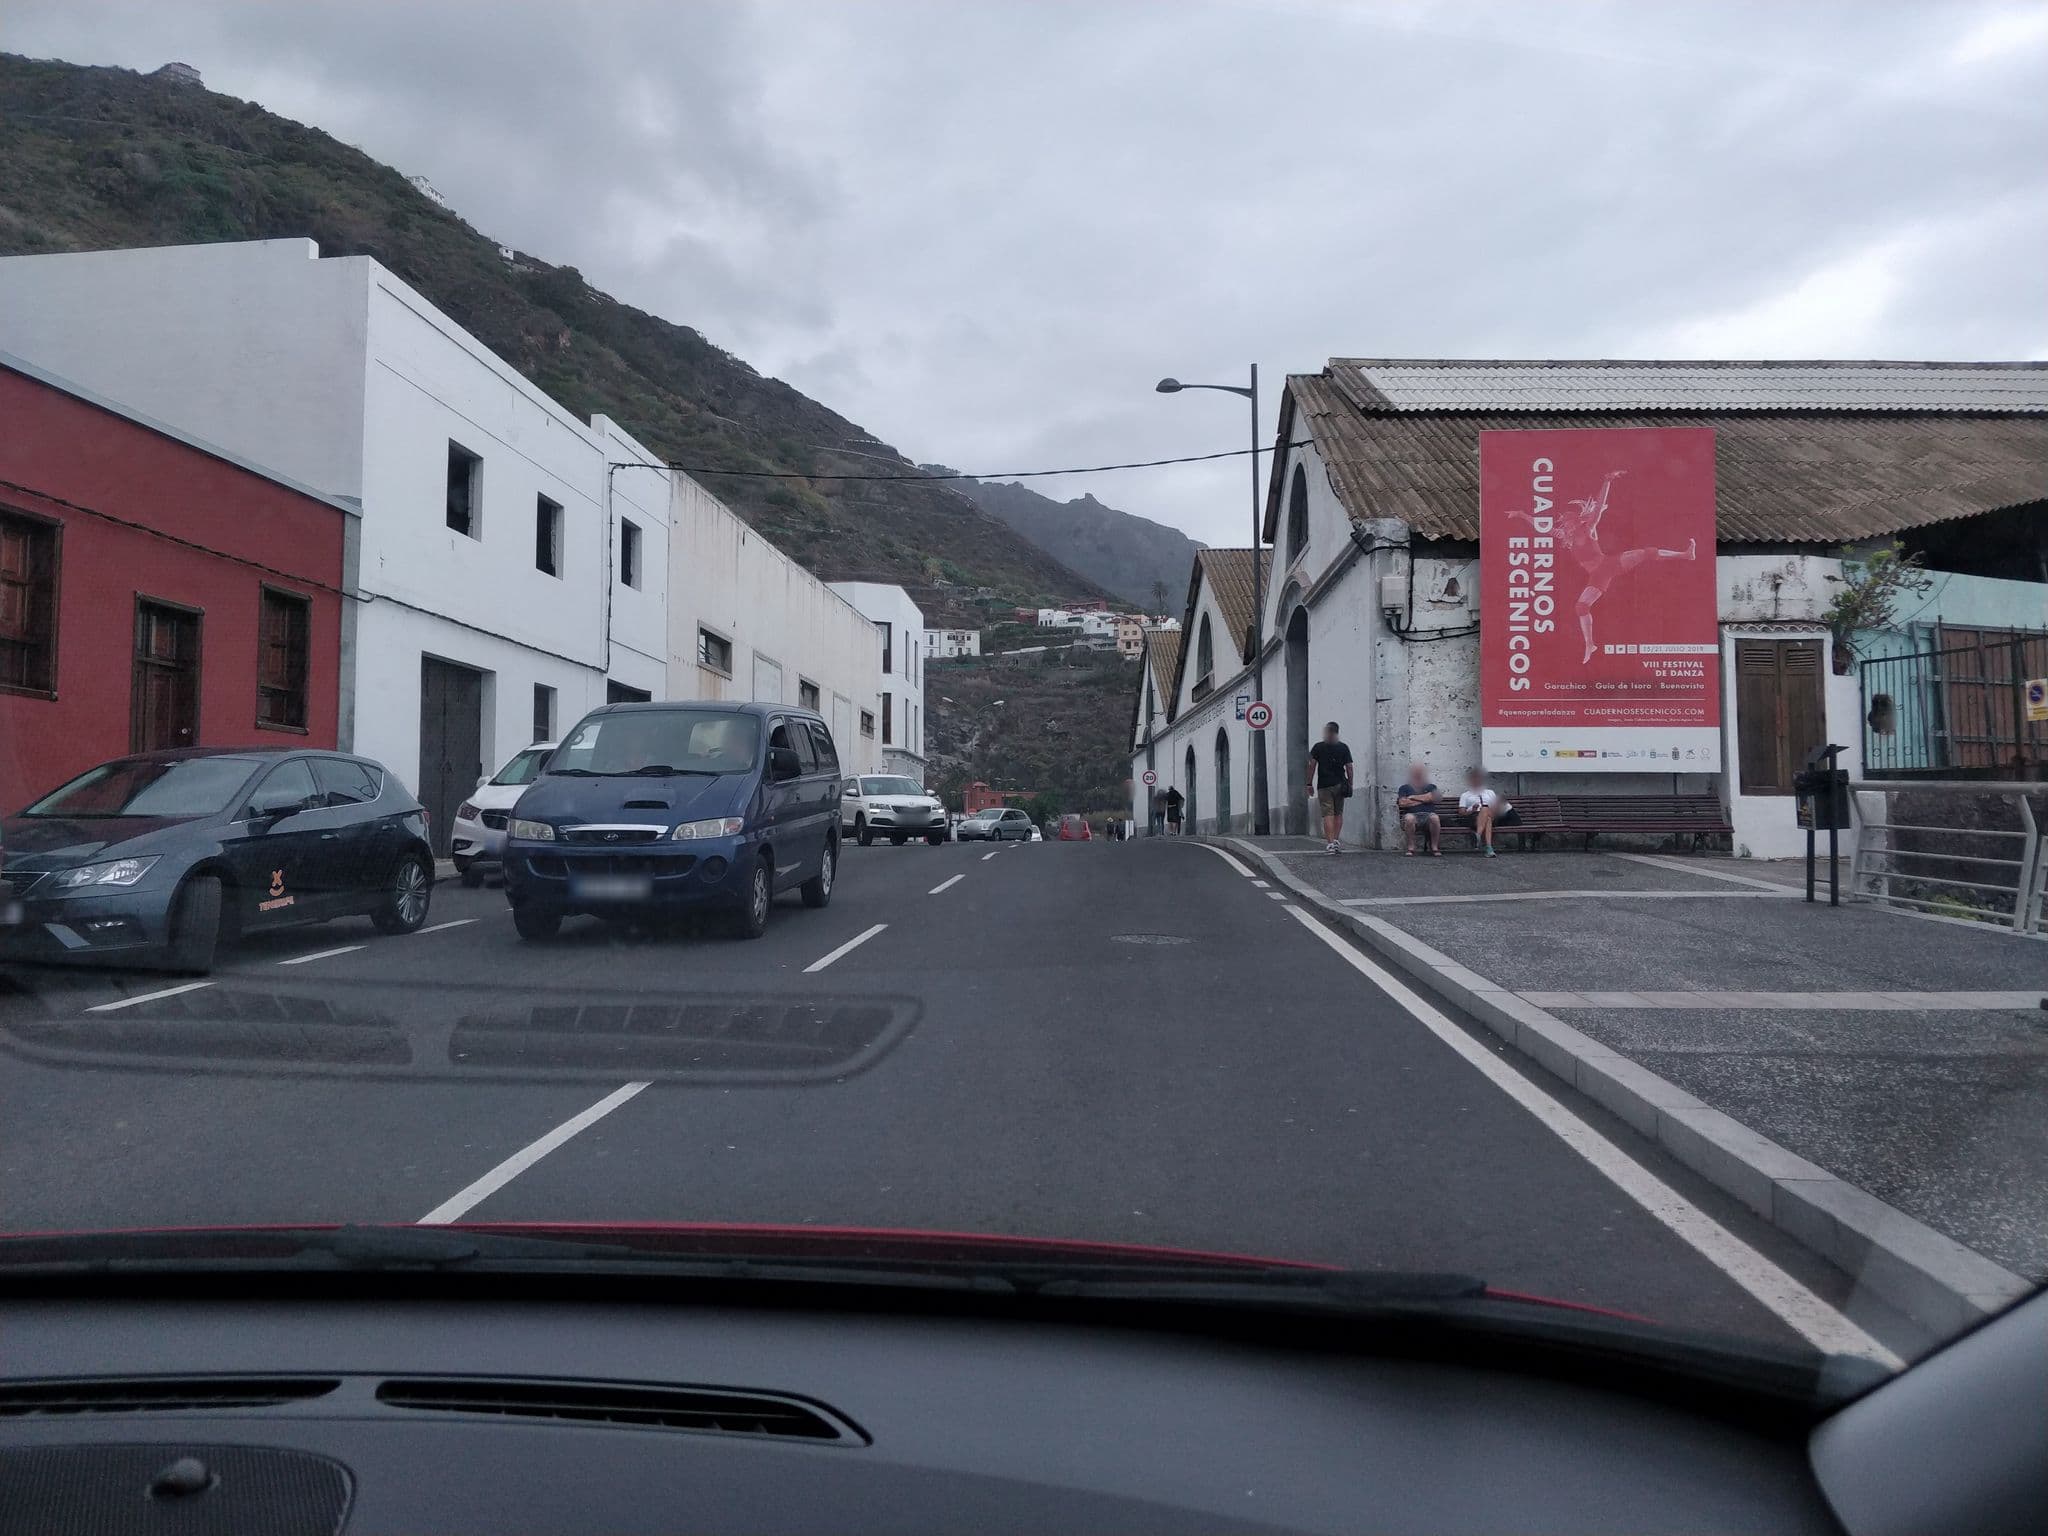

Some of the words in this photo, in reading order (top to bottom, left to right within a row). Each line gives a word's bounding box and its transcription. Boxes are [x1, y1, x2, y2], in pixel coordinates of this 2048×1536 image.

[1532, 457, 1554, 633] CUADERNOS
[1655, 669, 1668, 677] DE
[1670, 669, 1704, 677] DANZA
[1544, 682, 1587, 690] Garachico
[1618, 682, 1628, 690] de
[1631, 682, 1652, 690] Isora
[1660, 682, 1704, 690] Buenavista
[1251, 711, 1267, 720] 40
[1498, 708, 1576, 717] #quenopareladanza
